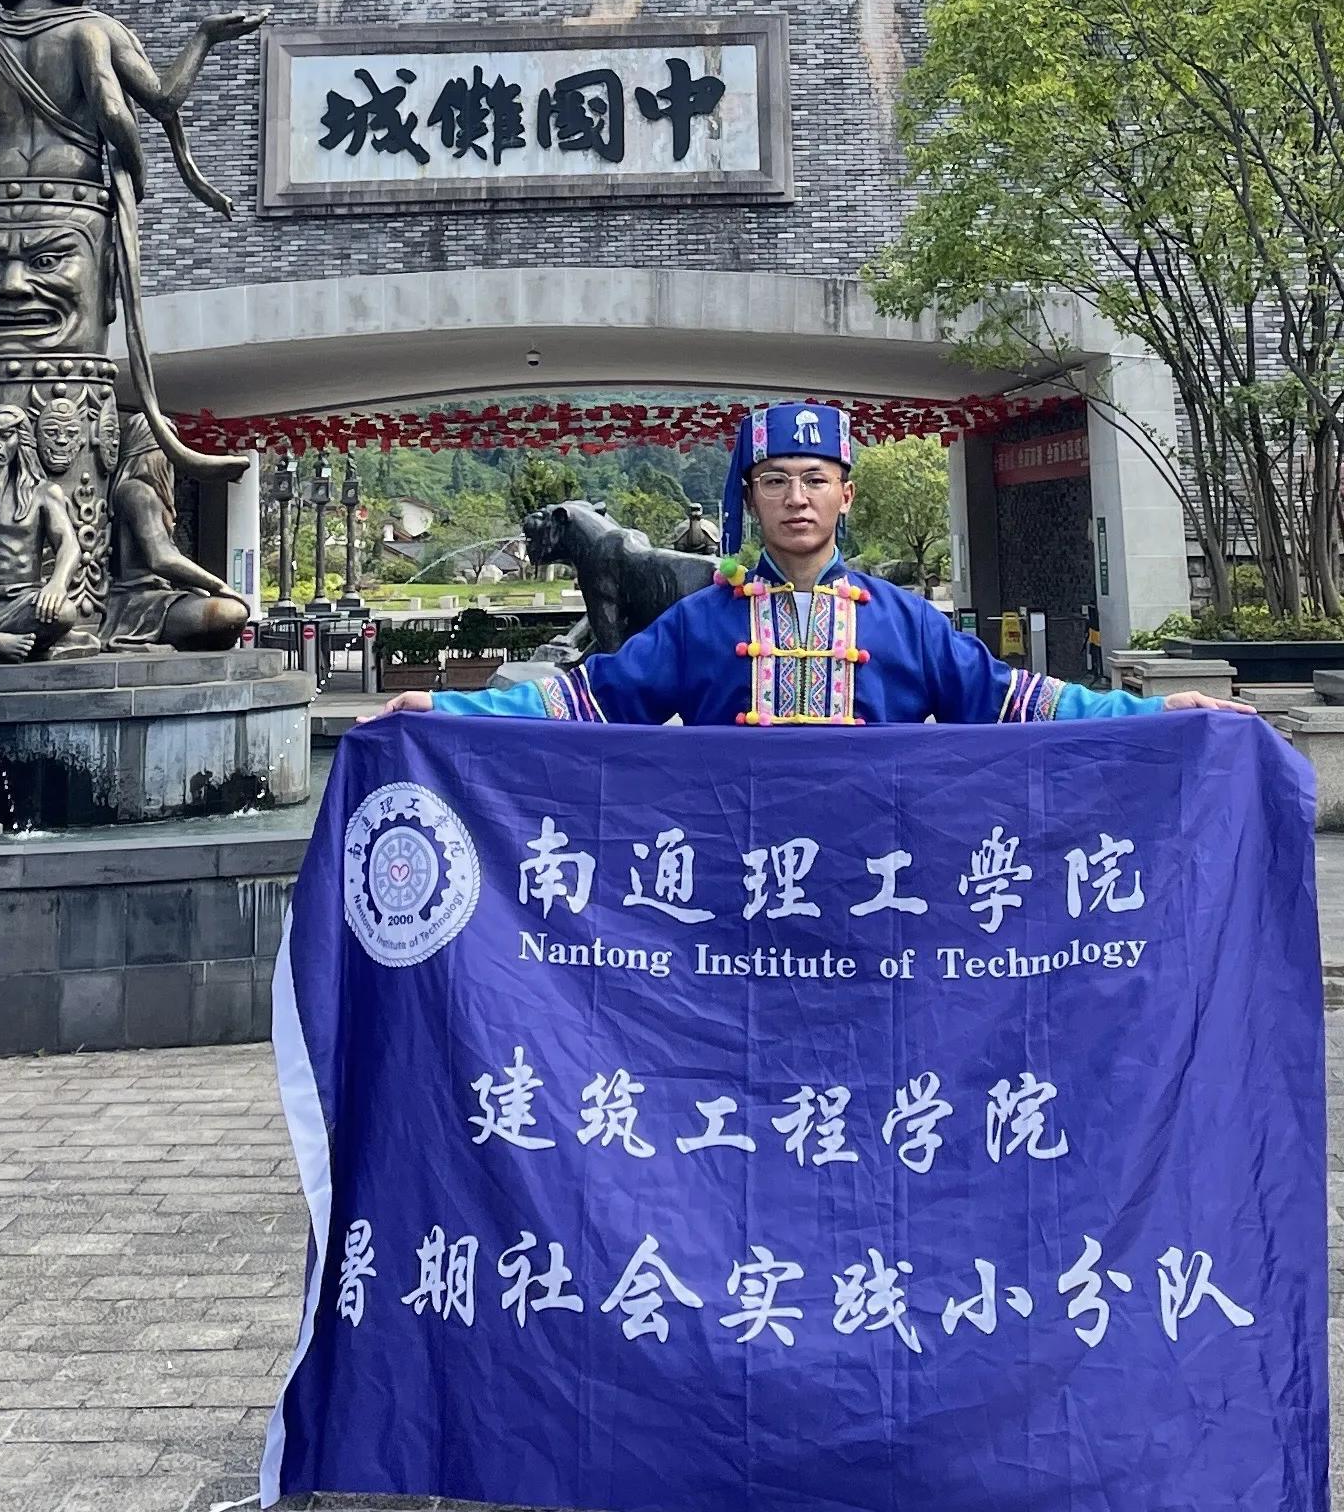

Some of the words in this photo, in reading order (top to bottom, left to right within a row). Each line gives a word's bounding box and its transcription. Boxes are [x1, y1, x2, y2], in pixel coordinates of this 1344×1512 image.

[420, 889, 465, 942] Technology
[518, 815, 1145, 934] 南通理工學院
[387, 914, 414, 927] 2000
[518, 930, 673, 978] Nantong
[694, 942, 857, 979] Institute
[879, 948, 917, 980] of
[936, 938, 1148, 980] Technology
[467, 1045, 1069, 1175] 建筑工程学院
[335, 1218, 1256, 1354] 暑期社会实践小分队
